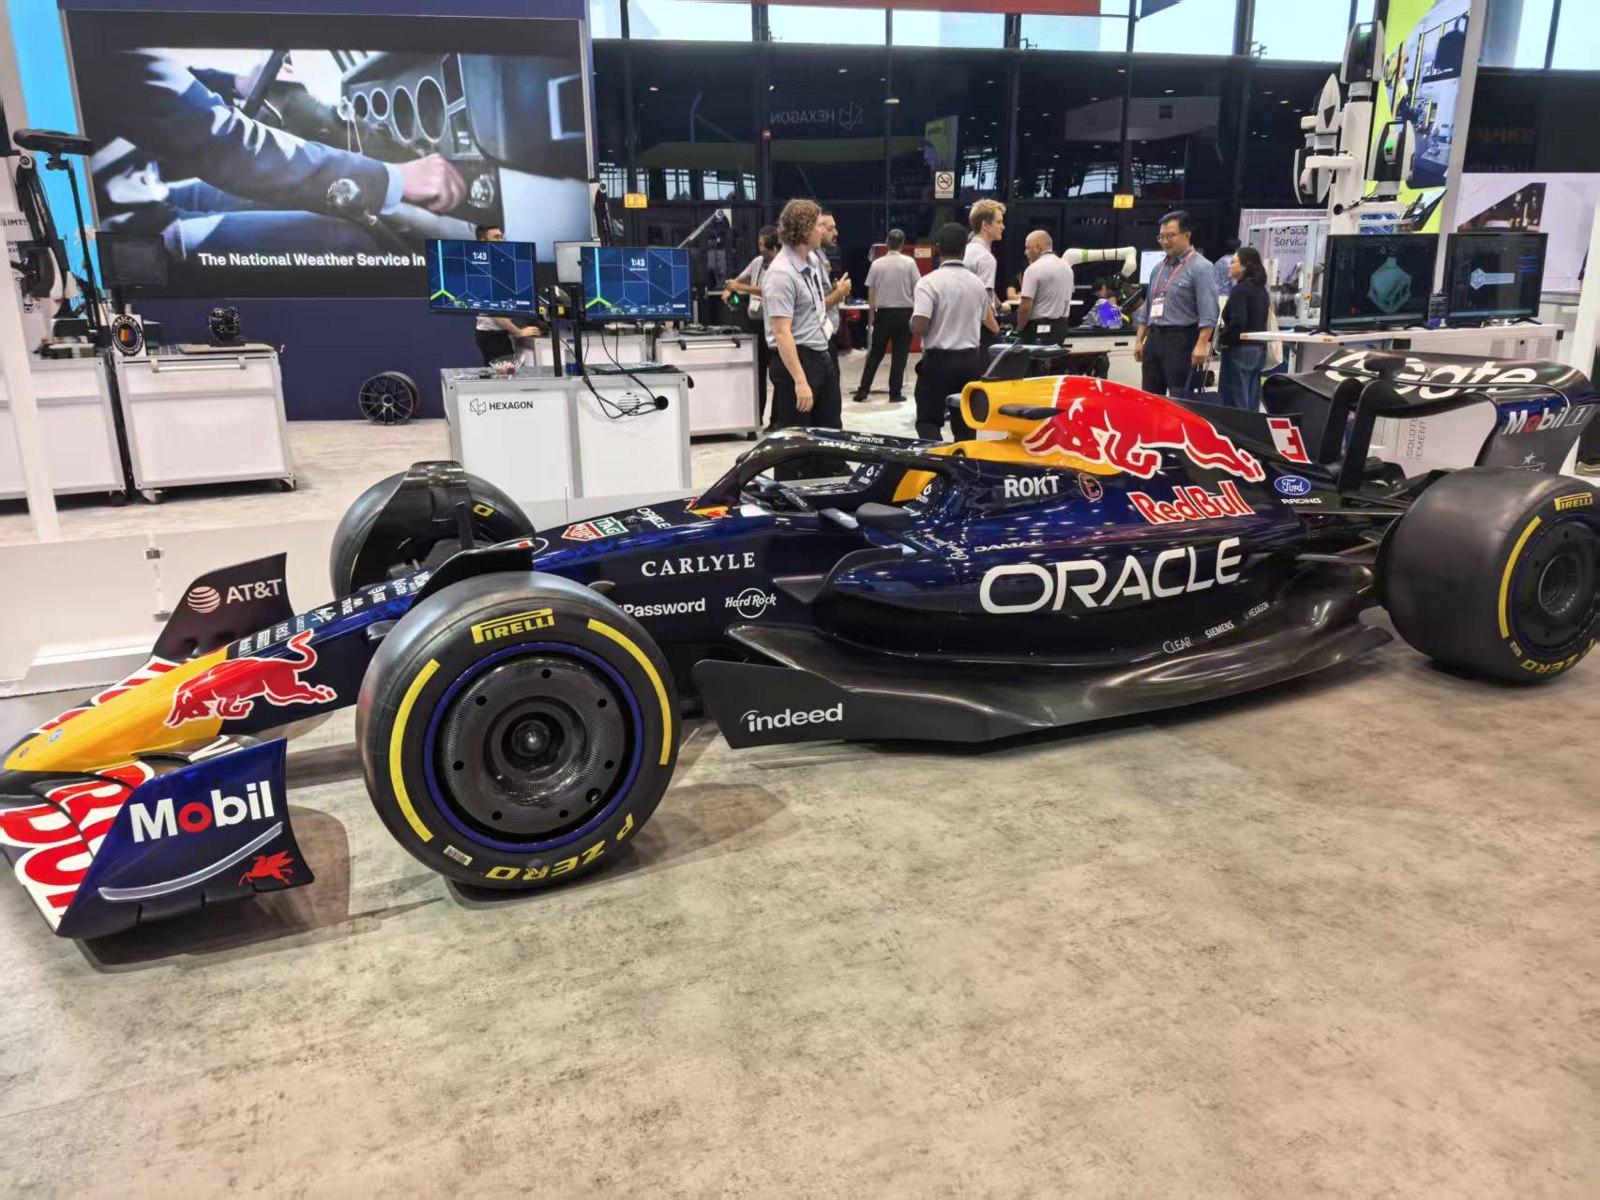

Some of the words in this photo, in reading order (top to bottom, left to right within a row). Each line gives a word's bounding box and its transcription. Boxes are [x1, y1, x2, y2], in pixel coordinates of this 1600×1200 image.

[198, 253, 226, 266] The
[229, 253, 291, 266] National
[293, 253, 354, 266] Weather
[357, 253, 410, 266] Service
[489, 401, 533, 410] HEXAGON
[1502, 407, 1569, 435] Mobil
[818, 440, 861, 451] DAMAC
[1004, 475, 1059, 498] ROKT
[1554, 492, 1593, 511] PIRELLI
[597, 519, 618, 535] TAG
[974, 540, 1043, 552] DAMAC
[641, 552, 755, 577] CARLYLE
[980, 537, 1241, 614] ORACLE
[226, 578, 282, 604] AT&T
[725, 596, 750, 608] Hard
[752, 594, 776, 607] Rock
[619, 598, 706, 617] Password
[471, 608, 555, 644] PIRELLI
[1204, 620, 1235, 639] SIEMENS
[741, 703, 843, 732] indeed
[129, 780, 275, 843] Mobil
[616, 813, 634, 841] P
[485, 840, 607, 880] ZERO
